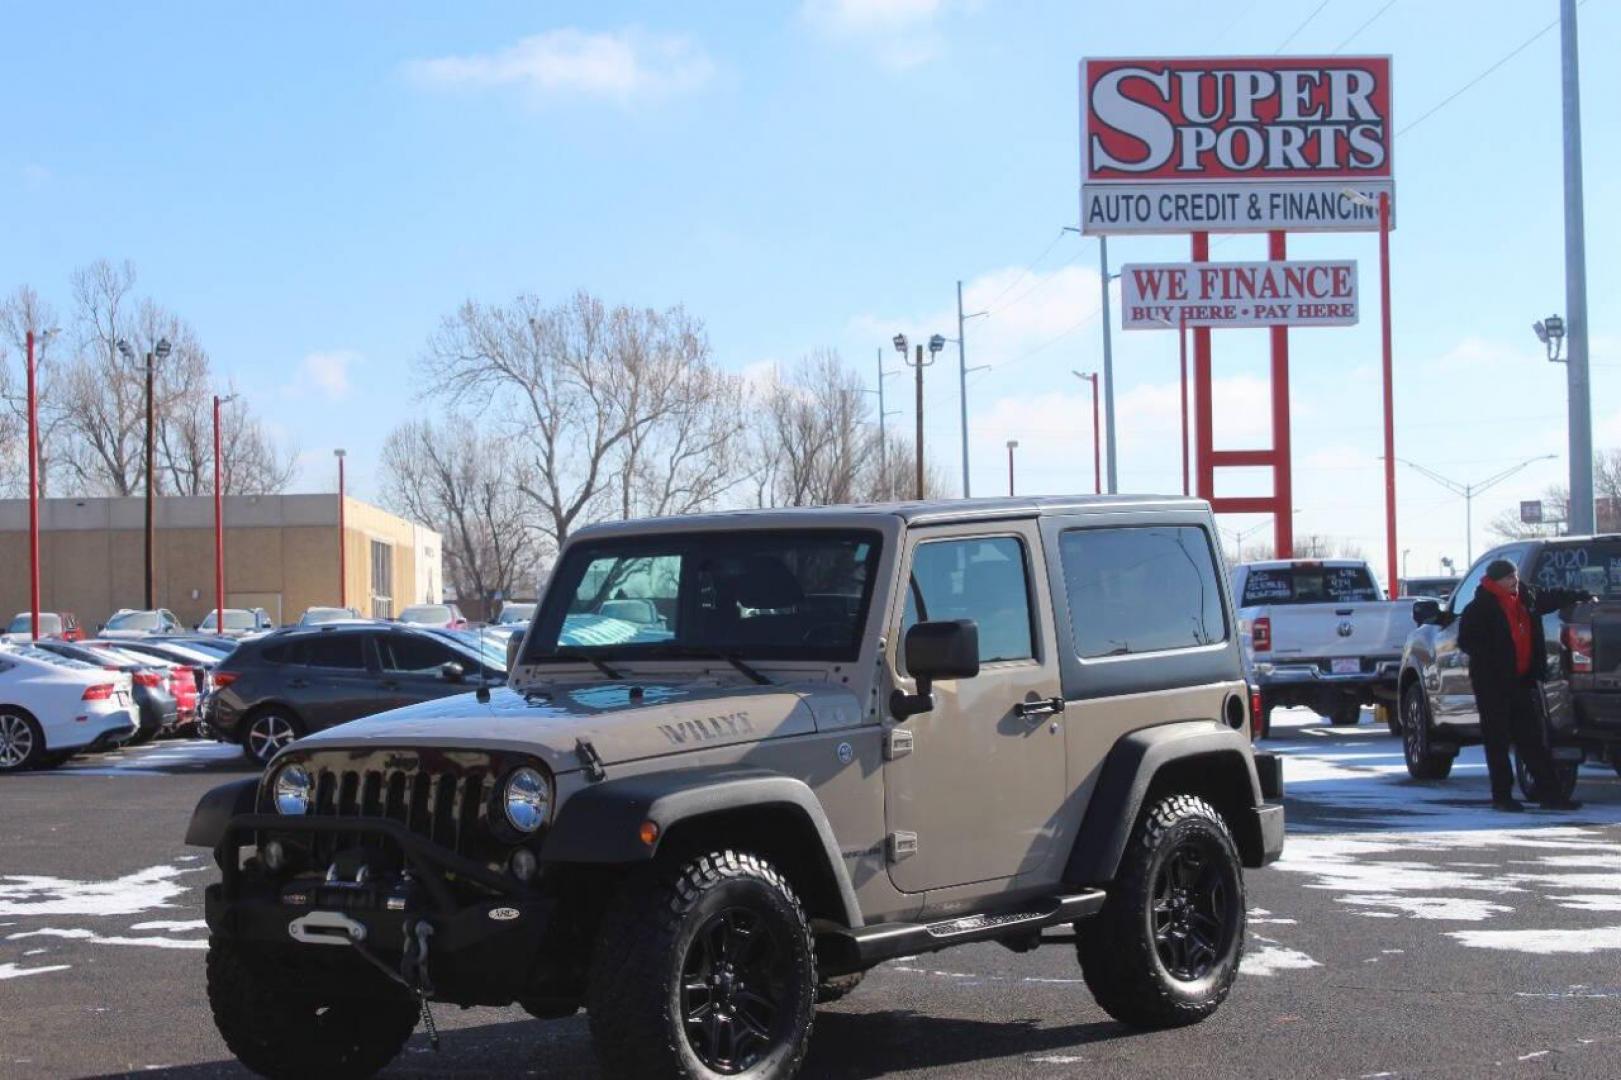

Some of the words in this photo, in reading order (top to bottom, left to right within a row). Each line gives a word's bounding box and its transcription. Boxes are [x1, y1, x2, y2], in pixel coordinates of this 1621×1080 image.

[1089, 194, 1151, 223] AUTO
[1158, 192, 1240, 222] CREDIT
[1246, 192, 1262, 221] &
[1269, 190, 1391, 221] FINANCIN
[1132, 268, 1188, 301] WE
[1198, 265, 1352, 300] FINANCE
[1132, 305, 1174, 321] BUY
[1178, 304, 1237, 320] HERE
[1253, 304, 1292, 319] PAY
[1297, 303, 1355, 318] HERE
[1543, 547, 1588, 570] 2020
